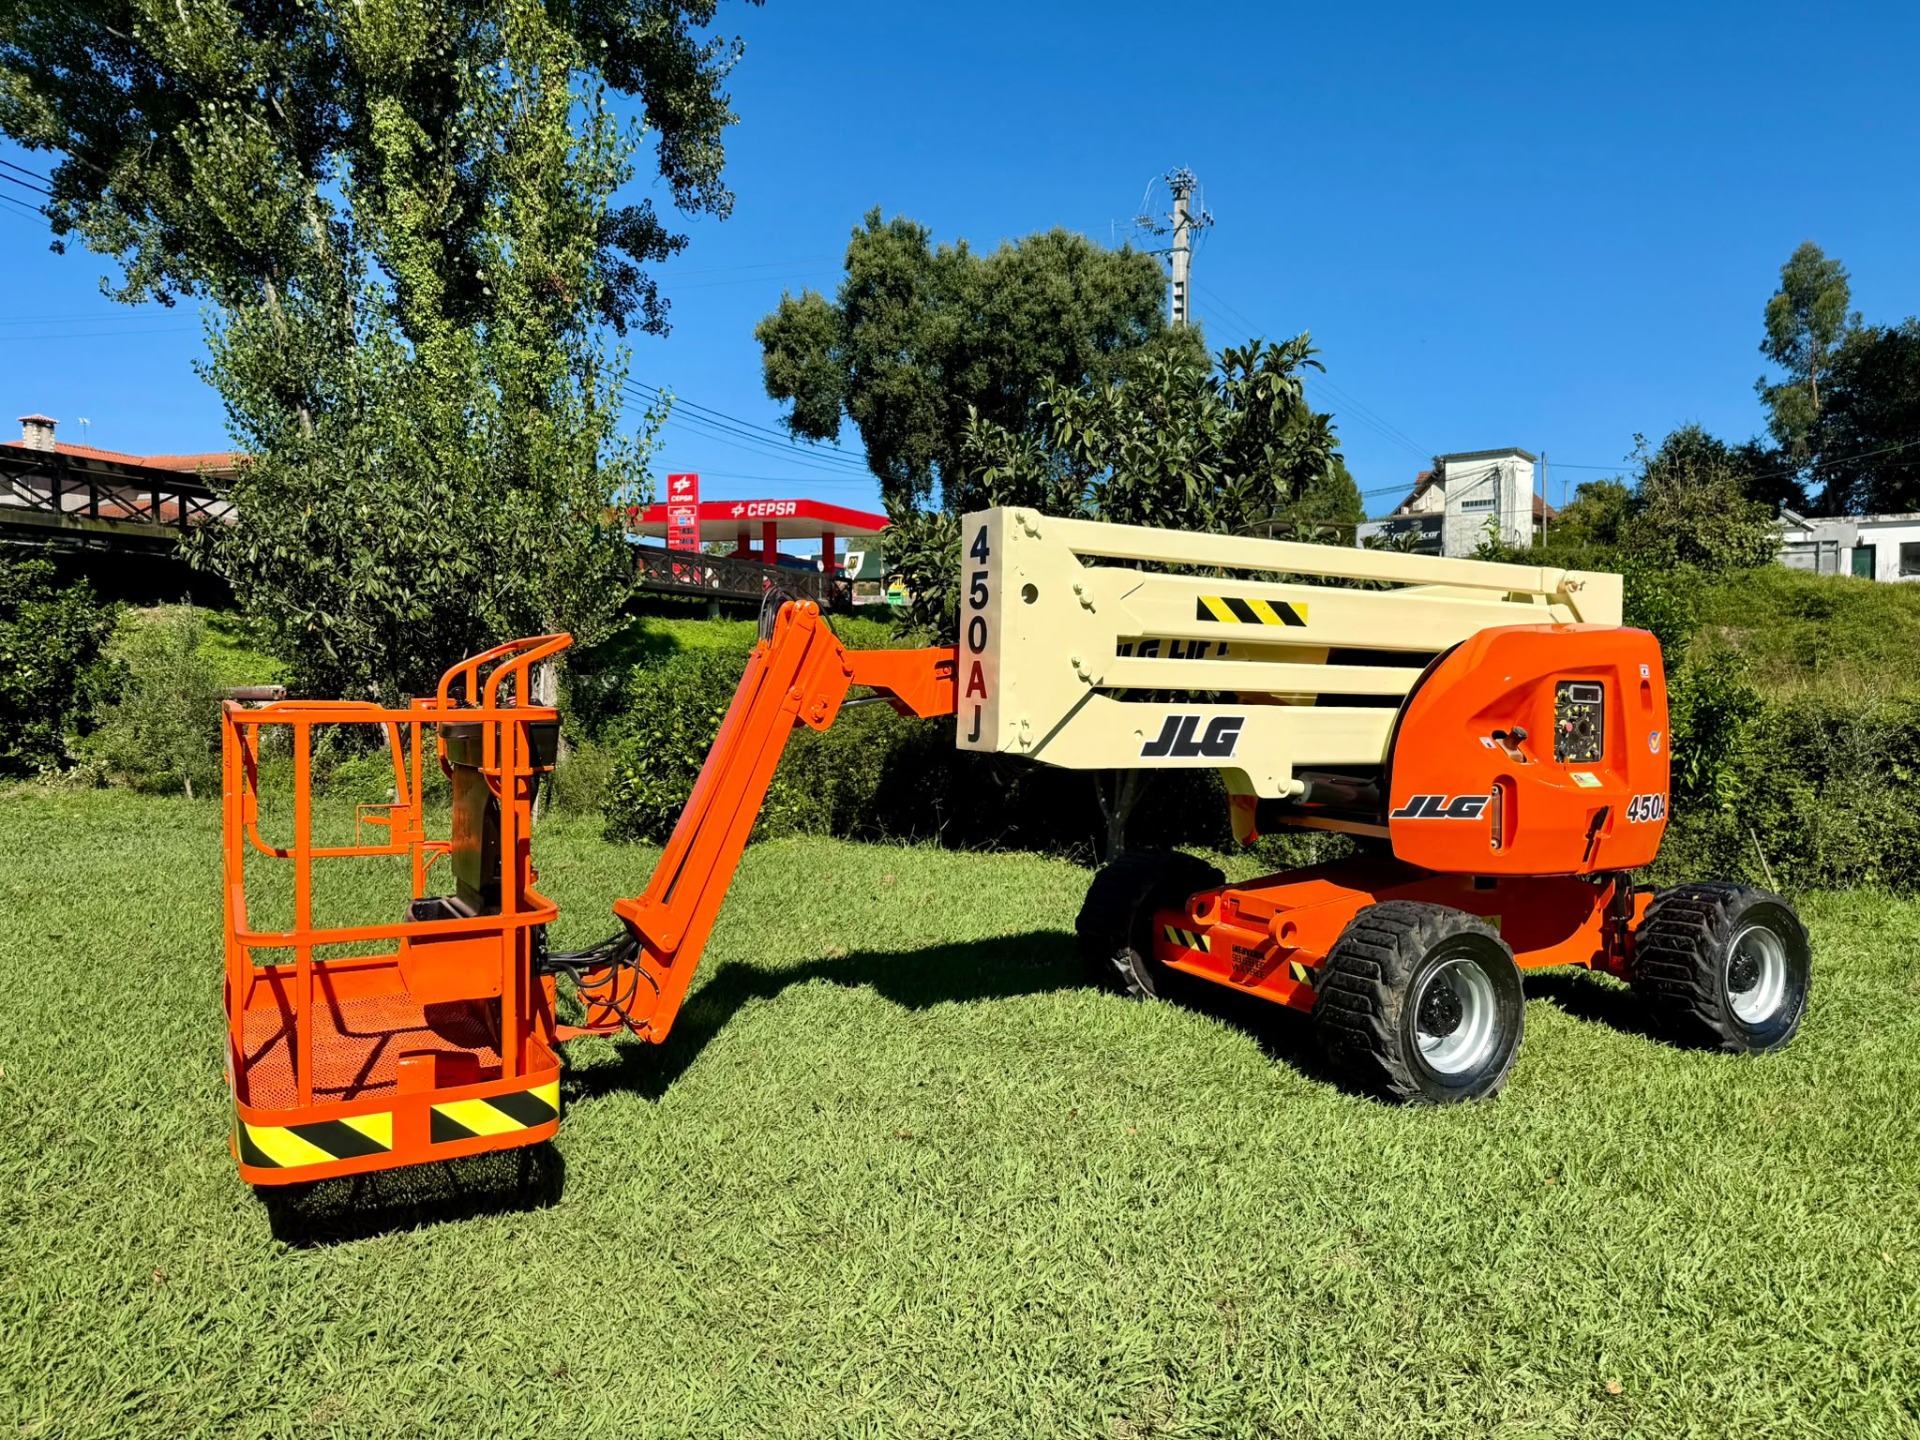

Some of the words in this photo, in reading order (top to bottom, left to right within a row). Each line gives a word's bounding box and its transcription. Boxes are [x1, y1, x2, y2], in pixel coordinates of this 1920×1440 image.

[747, 502, 796, 517] CEPSA
[1140, 715, 1245, 757] JLG
[1390, 795, 1491, 819] JLG
